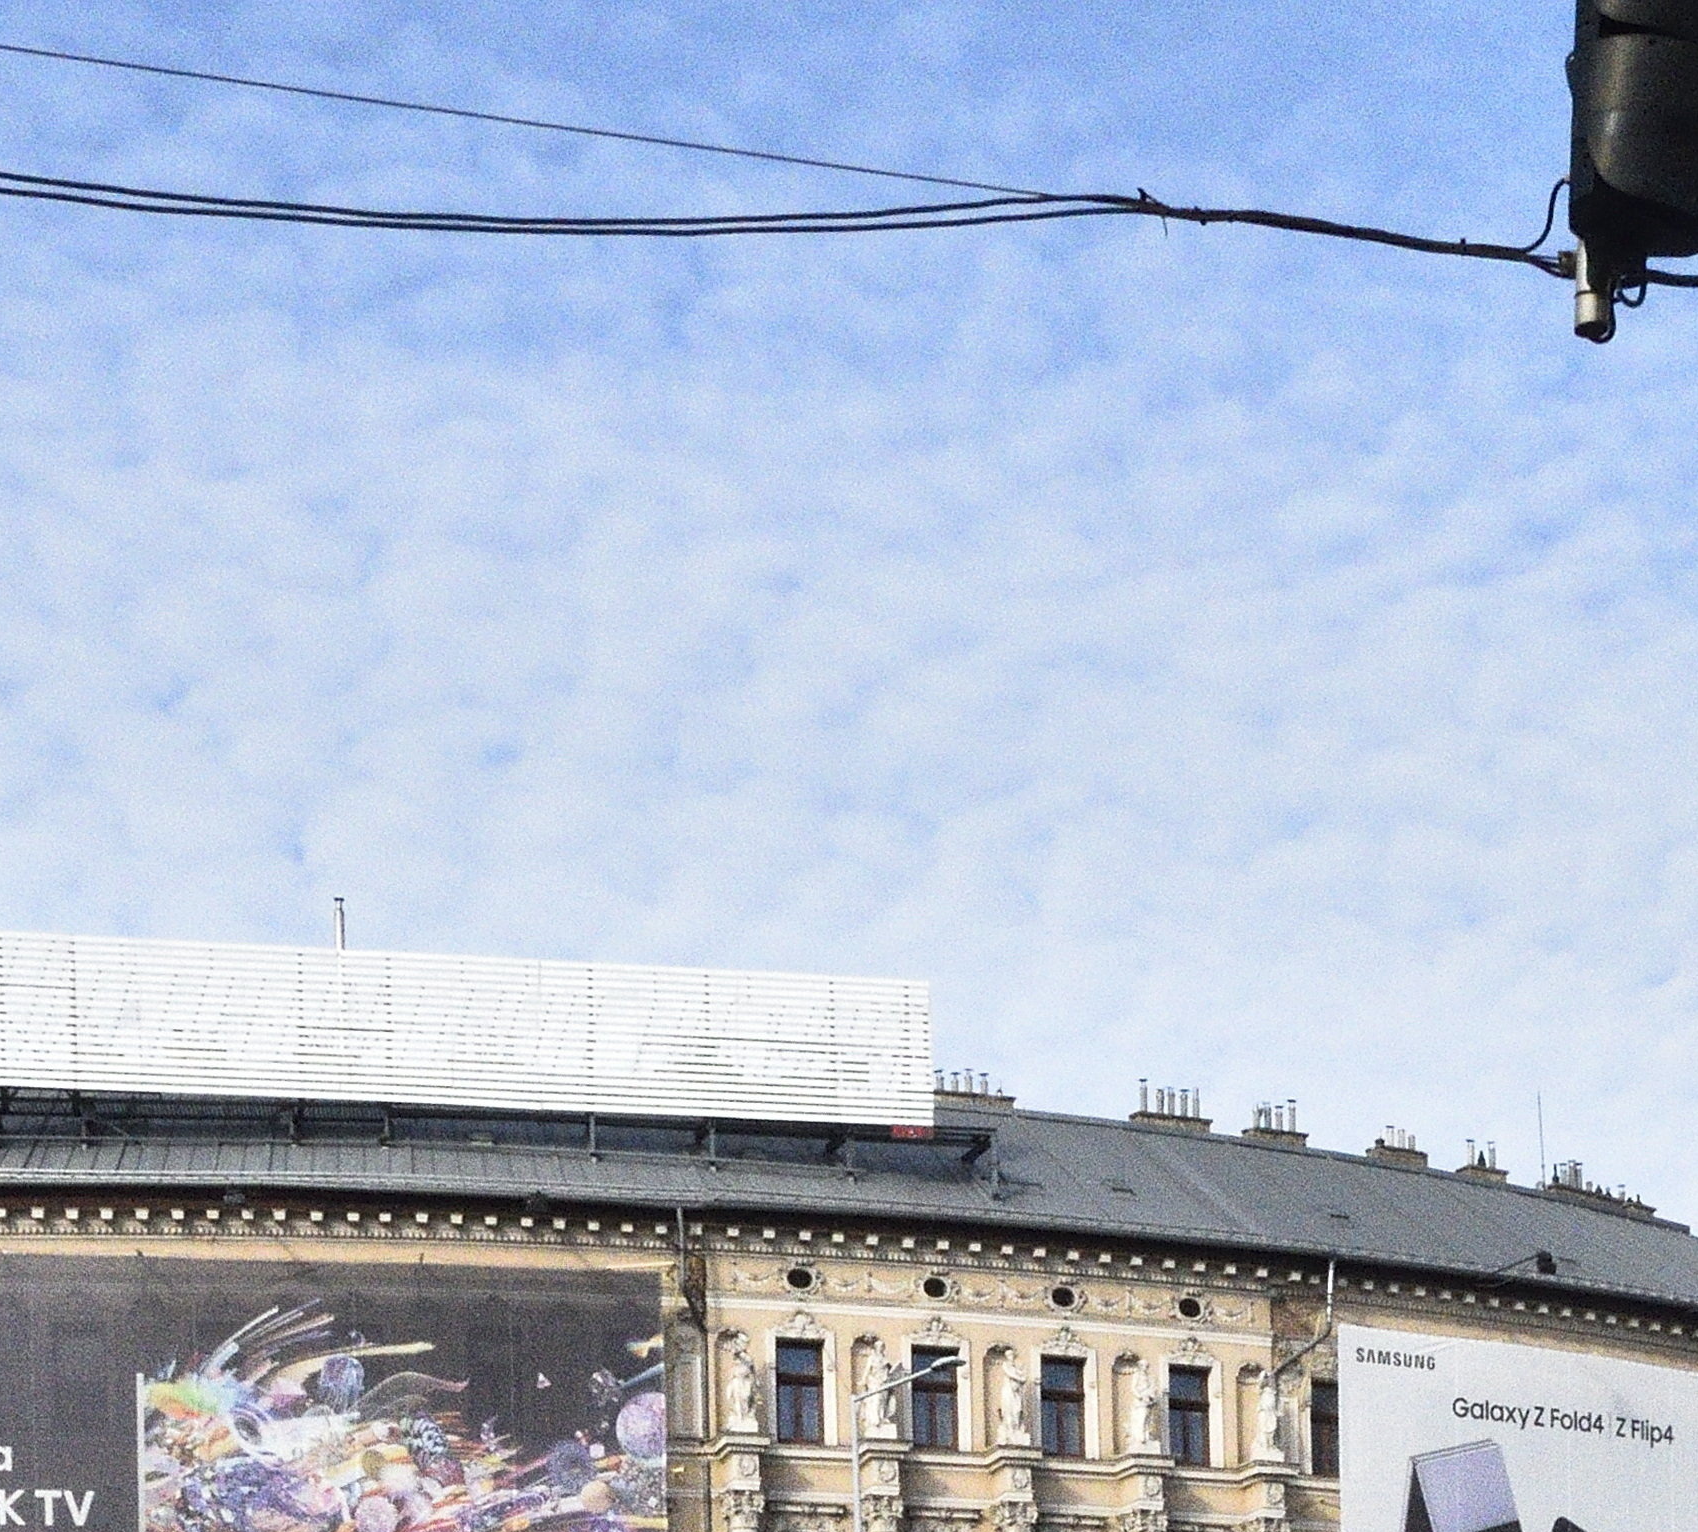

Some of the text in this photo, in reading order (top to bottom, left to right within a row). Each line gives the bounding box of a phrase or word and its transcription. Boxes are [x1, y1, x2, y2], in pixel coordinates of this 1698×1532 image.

[1356, 1348, 1436, 1370] SAMSUNG
[1452, 1397, 1675, 1448] Galaxy Z Fold4 Z Flip4
[34, 1490, 95, 1527] TV
